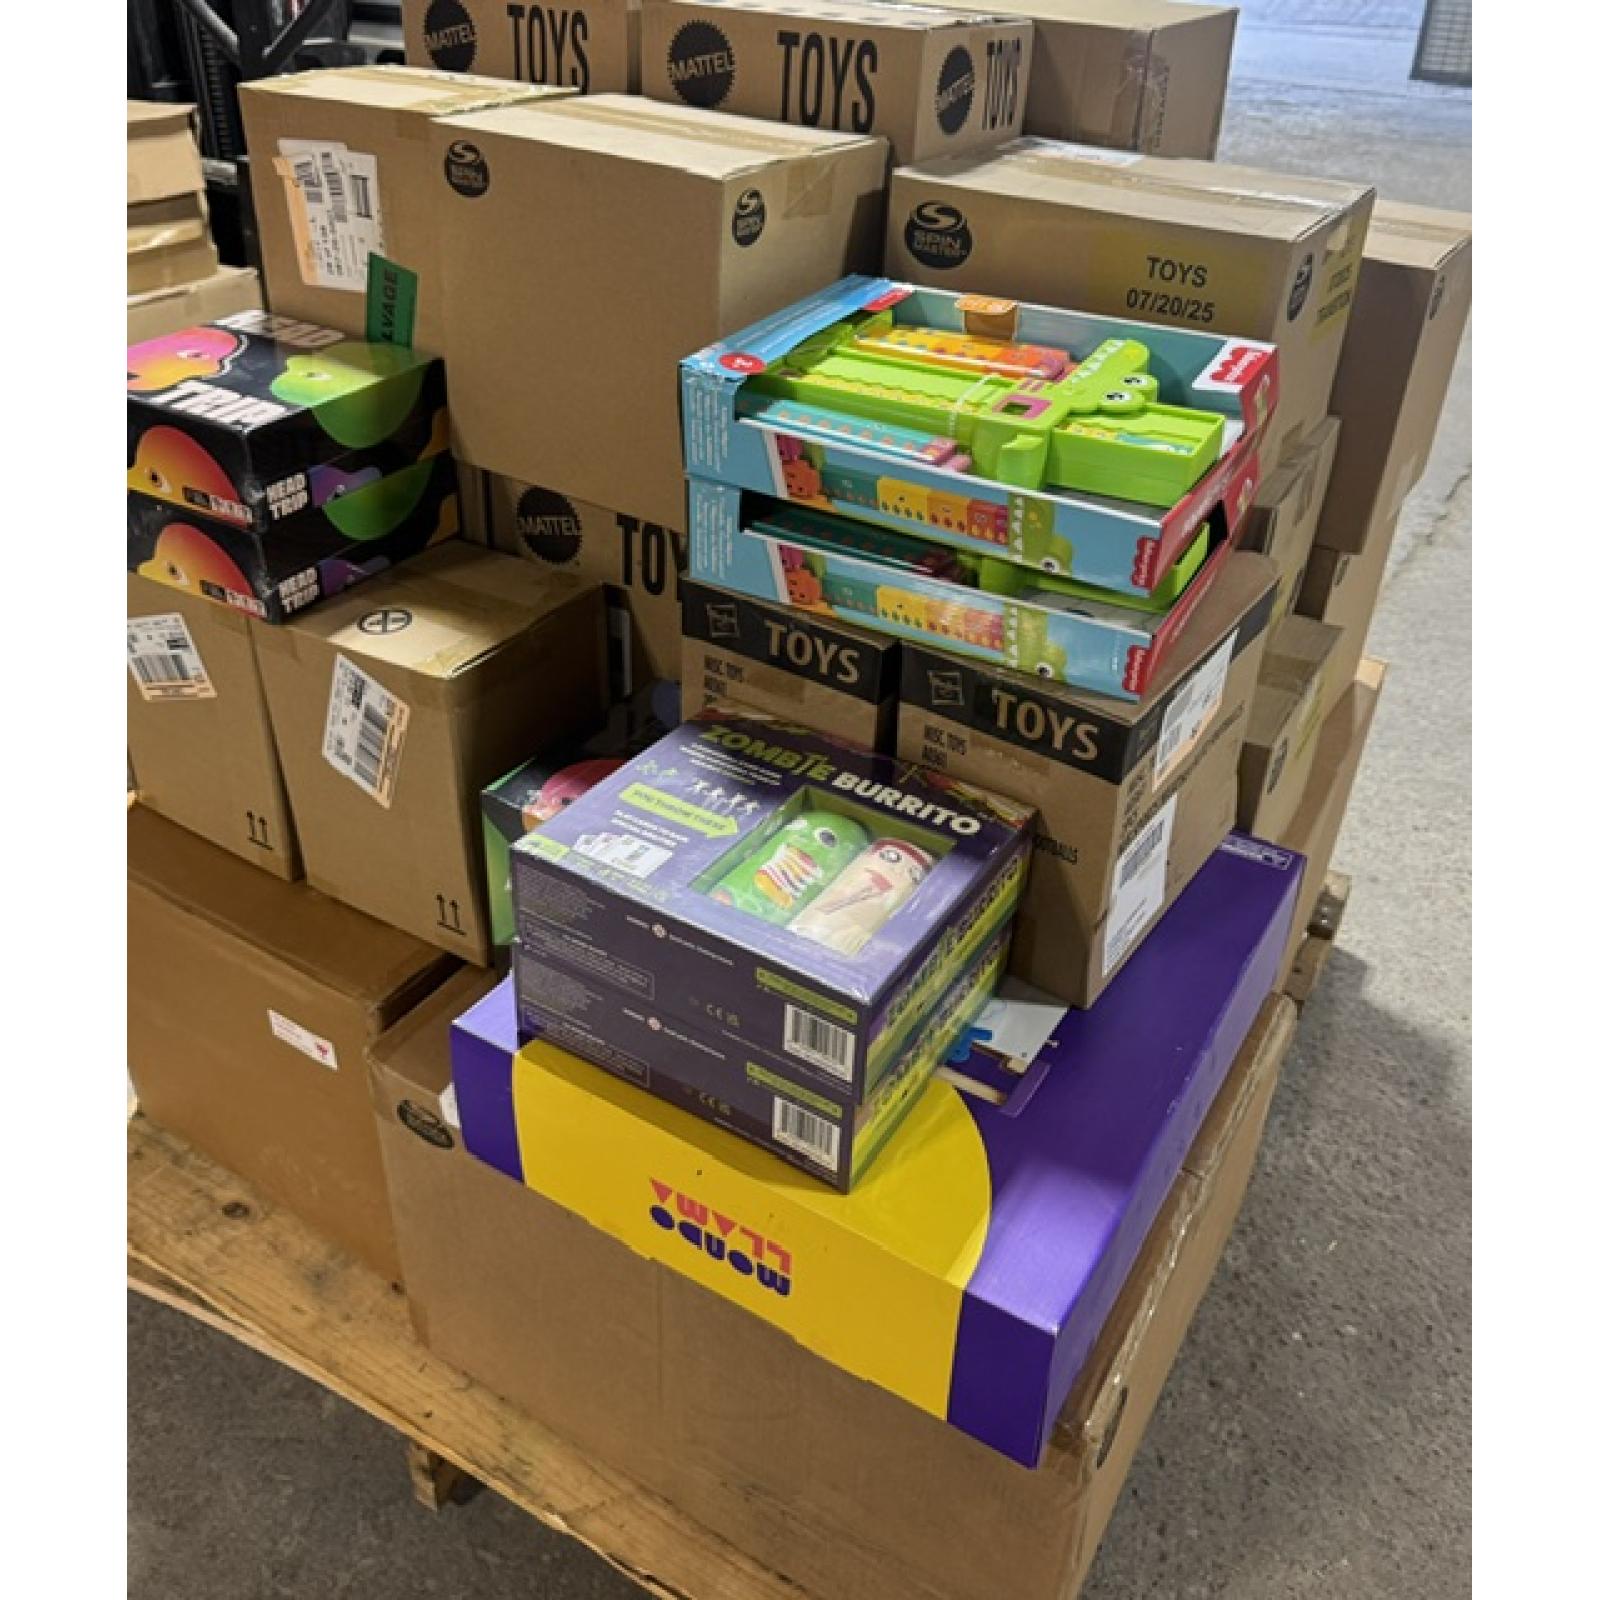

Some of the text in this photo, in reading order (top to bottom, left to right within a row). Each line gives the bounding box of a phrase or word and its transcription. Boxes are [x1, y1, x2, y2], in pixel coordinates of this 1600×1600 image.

[507, 4, 590, 95] TOYS
[668, 53, 735, 81] MATTEL
[777, 30, 878, 135] TOYS
[981, 37, 1021, 131] TOYS
[1126, 287, 1216, 323] 07/20/25
[1146, 254, 1208, 288] TOYS
[517, 513, 584, 538] MATTEL
[764, 617, 861, 684] TOYS
[991, 689, 1099, 761] TOYS
[700, 724, 837, 781] ZOMBIE
[831, 771, 981, 836] BURRITO
